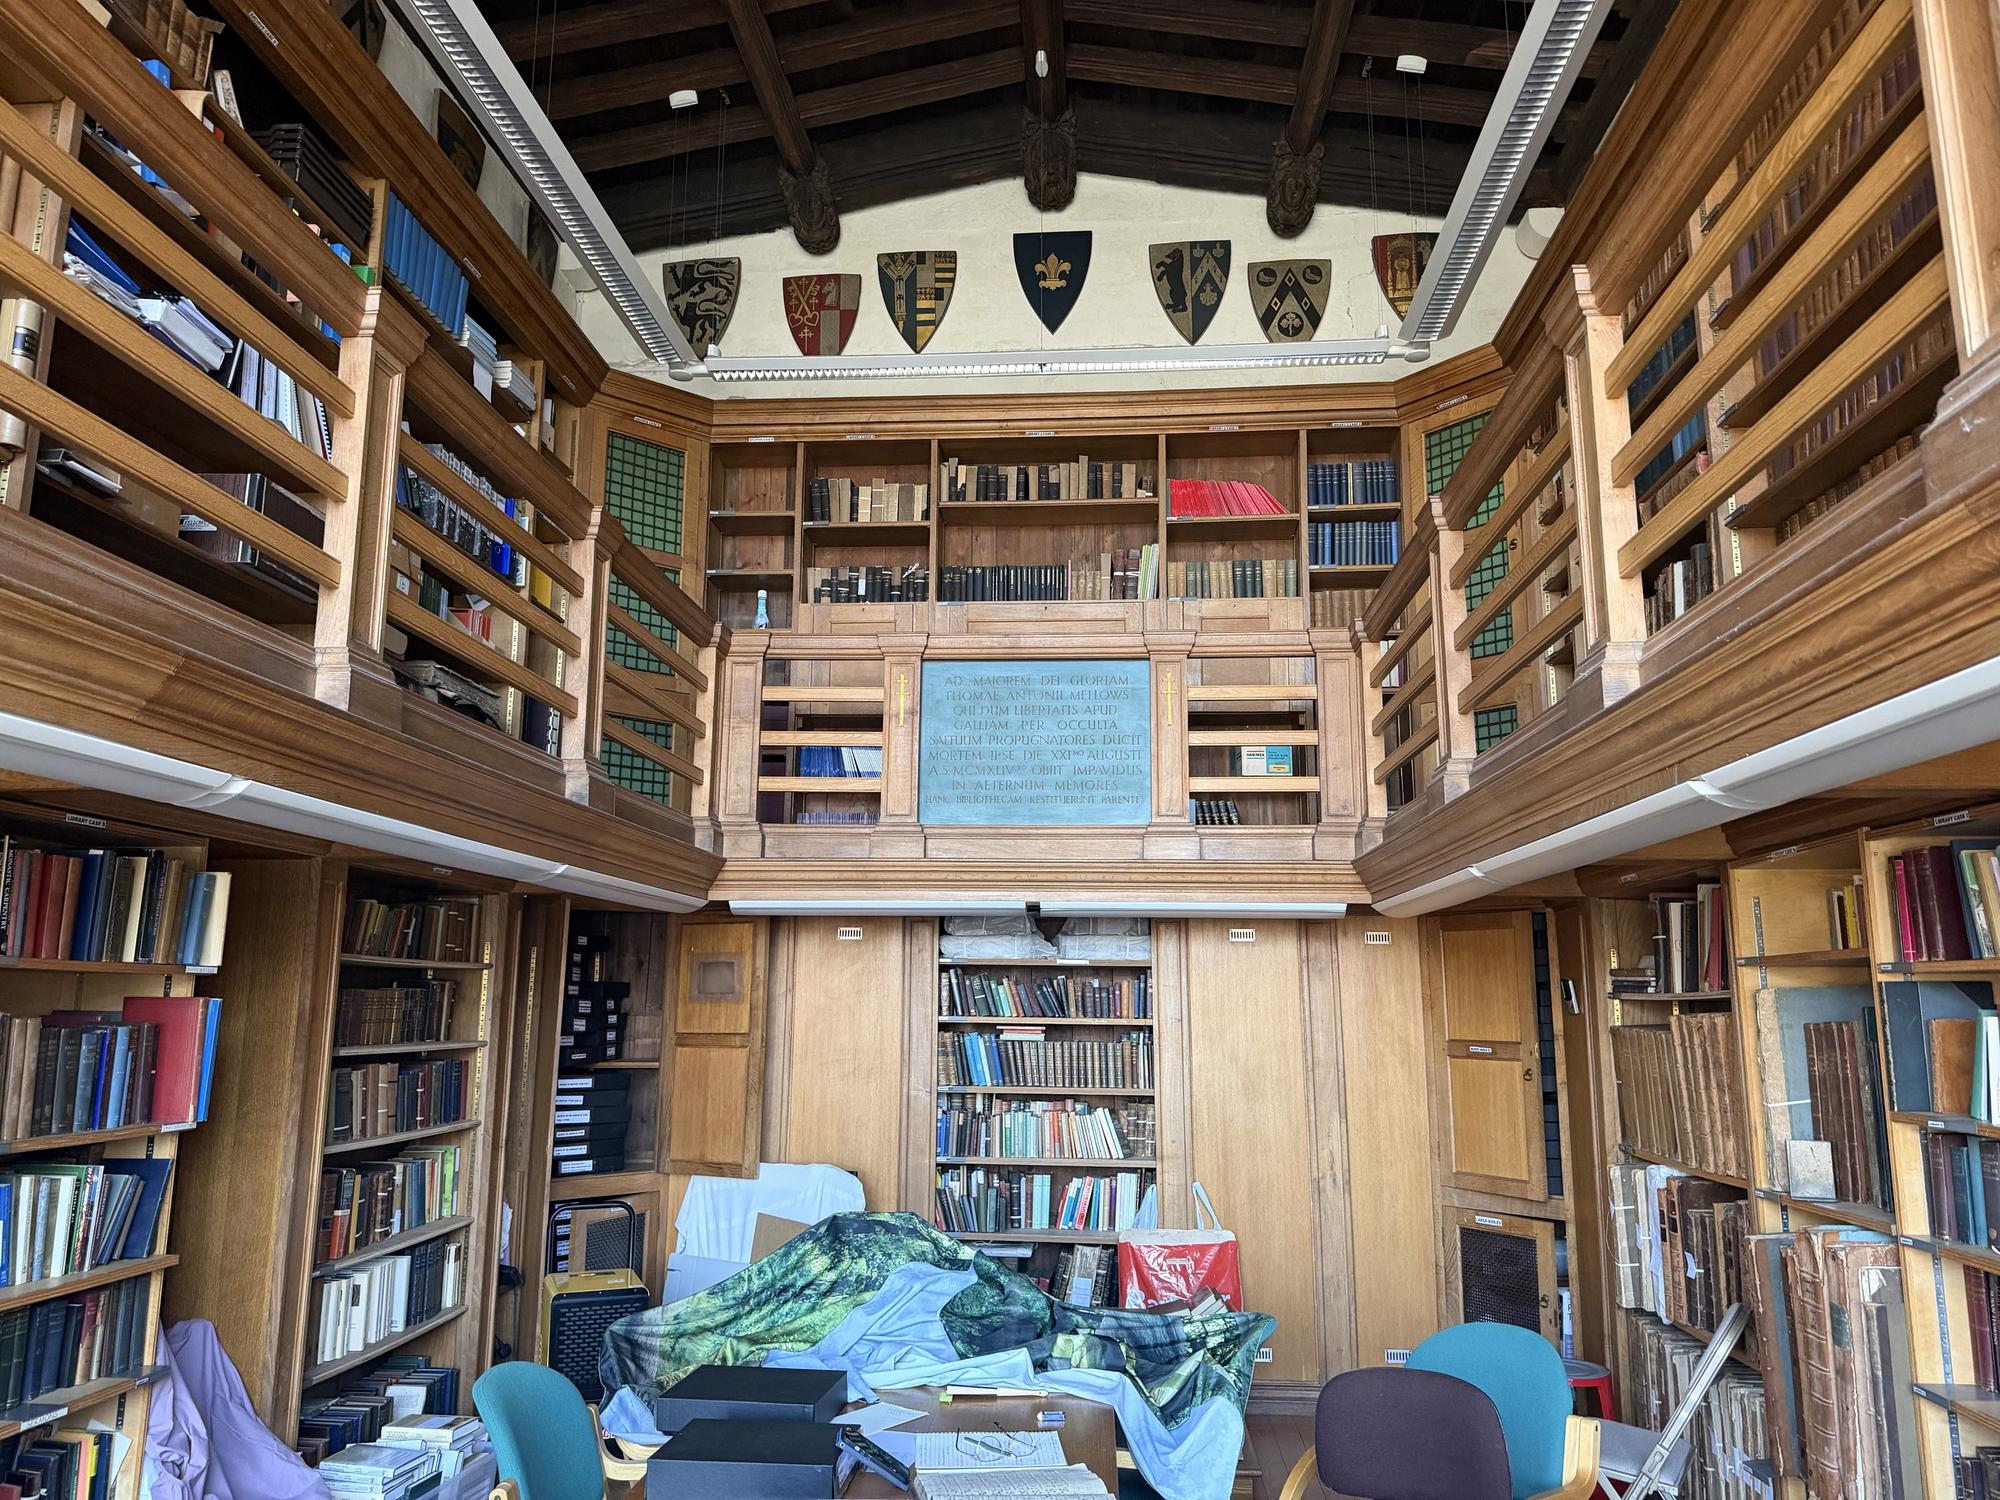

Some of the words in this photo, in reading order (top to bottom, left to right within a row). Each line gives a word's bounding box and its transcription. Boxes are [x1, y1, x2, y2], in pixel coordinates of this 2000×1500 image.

[944, 676, 963, 687] AD
[973, 675, 1031, 687] MAIOREM
[1040, 675, 1060, 686] DEI
[1070, 675, 1129, 686] GLORIAM
[945, 691, 1000, 701] THOMAE
[1006, 690, 1064, 701] ANTONII
[1070, 690, 1129, 700] MELLOWS
[952, 705, 976, 716] QUI
[980, 705, 1009, 716] DUM
[1014, 704, 1079, 716] LIBERTATIS
[1083, 704, 1118, 715] APUD
[953, 719, 1009, 730] GALLIAM
[1021, 719, 1045, 730] PER
[1056, 719, 1118, 730] OCCULTA
[988, 734, 1096, 746] PROPUGNATORES
[1102, 734, 1143, 745] DUCIT
[928, 750, 982, 761] MORTEM
[990, 750, 1015, 761] IPSE
[1023, 750, 1043, 761] DIE
[1086, 749, 1142, 761] AUGUSTI
[1031, 764, 1065, 776] OBIIT
[1073, 764, 1143, 776] IMPAVIDUS
[952, 779, 966, 791] IN
[974, 779, 1045, 791] AETERNUM
[1054, 779, 1119, 791] MEMORES
[956, 794, 1022, 804] BIBLIOTHECAM
[1029, 794, 1097, 804] RESTITUERUNT
[1101, 794, 1146, 804] PARENTES
[68, 815, 88, 824] LIBRARY
[1935, 816, 1953, 825] LIBRARY
[5, 849, 14, 886] MONASTIC
[1, 887, 10, 930] CARPENTRY
